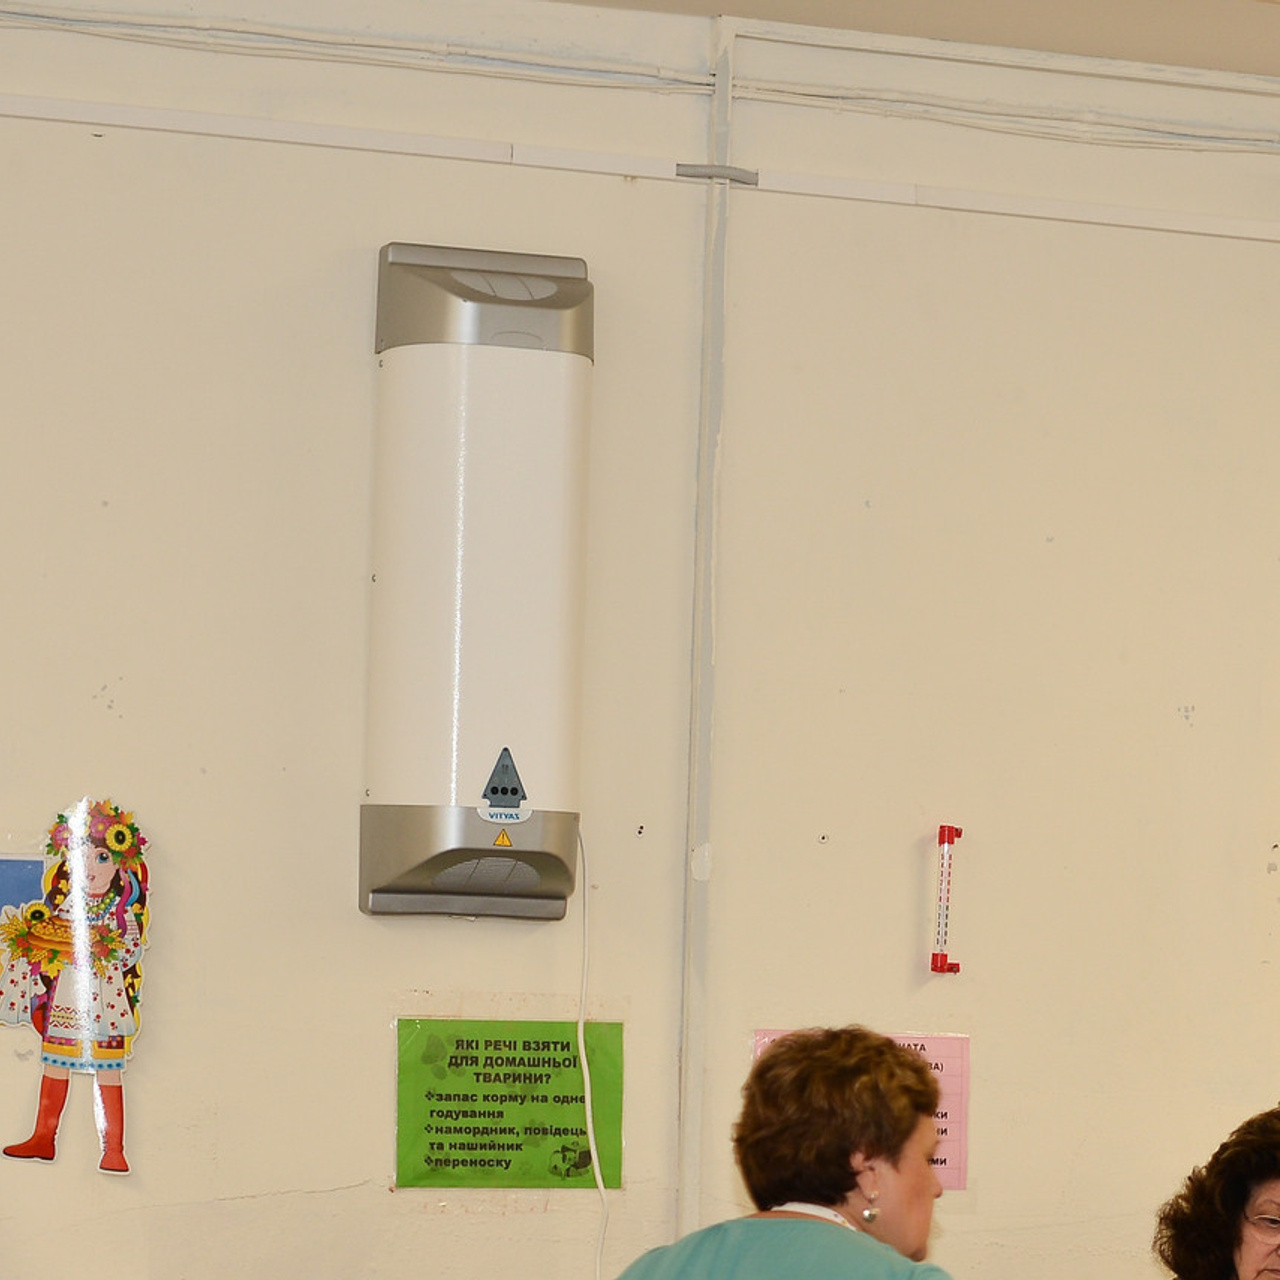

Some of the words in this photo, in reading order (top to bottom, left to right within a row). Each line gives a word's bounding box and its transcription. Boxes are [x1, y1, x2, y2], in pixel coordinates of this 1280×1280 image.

[488, 811, 520, 820] VITYAS
[455, 1039, 479, 1051] ЯКІ
[484, 1040, 517, 1051] РЕЧІ
[522, 1040, 571, 1052] ВЗЯТИ
[448, 1056, 479, 1068] ДЛЯ
[483, 1056, 578, 1068] ДОМАШНЬОЇ
[474, 1072, 552, 1084] ТВАРИНИ?
[435, 1092, 478, 1102] запас
[483, 1093, 527, 1105] корму
[531, 1094, 549, 1103] на
[430, 1109, 504, 1120] годування
[435, 1124, 520, 1136] намордник,
[524, 1125, 587, 1138] повідець
[429, 1141, 444, 1151] та
[449, 1140, 523, 1151] нашийник
[435, 1158, 512, 1170] переноску
